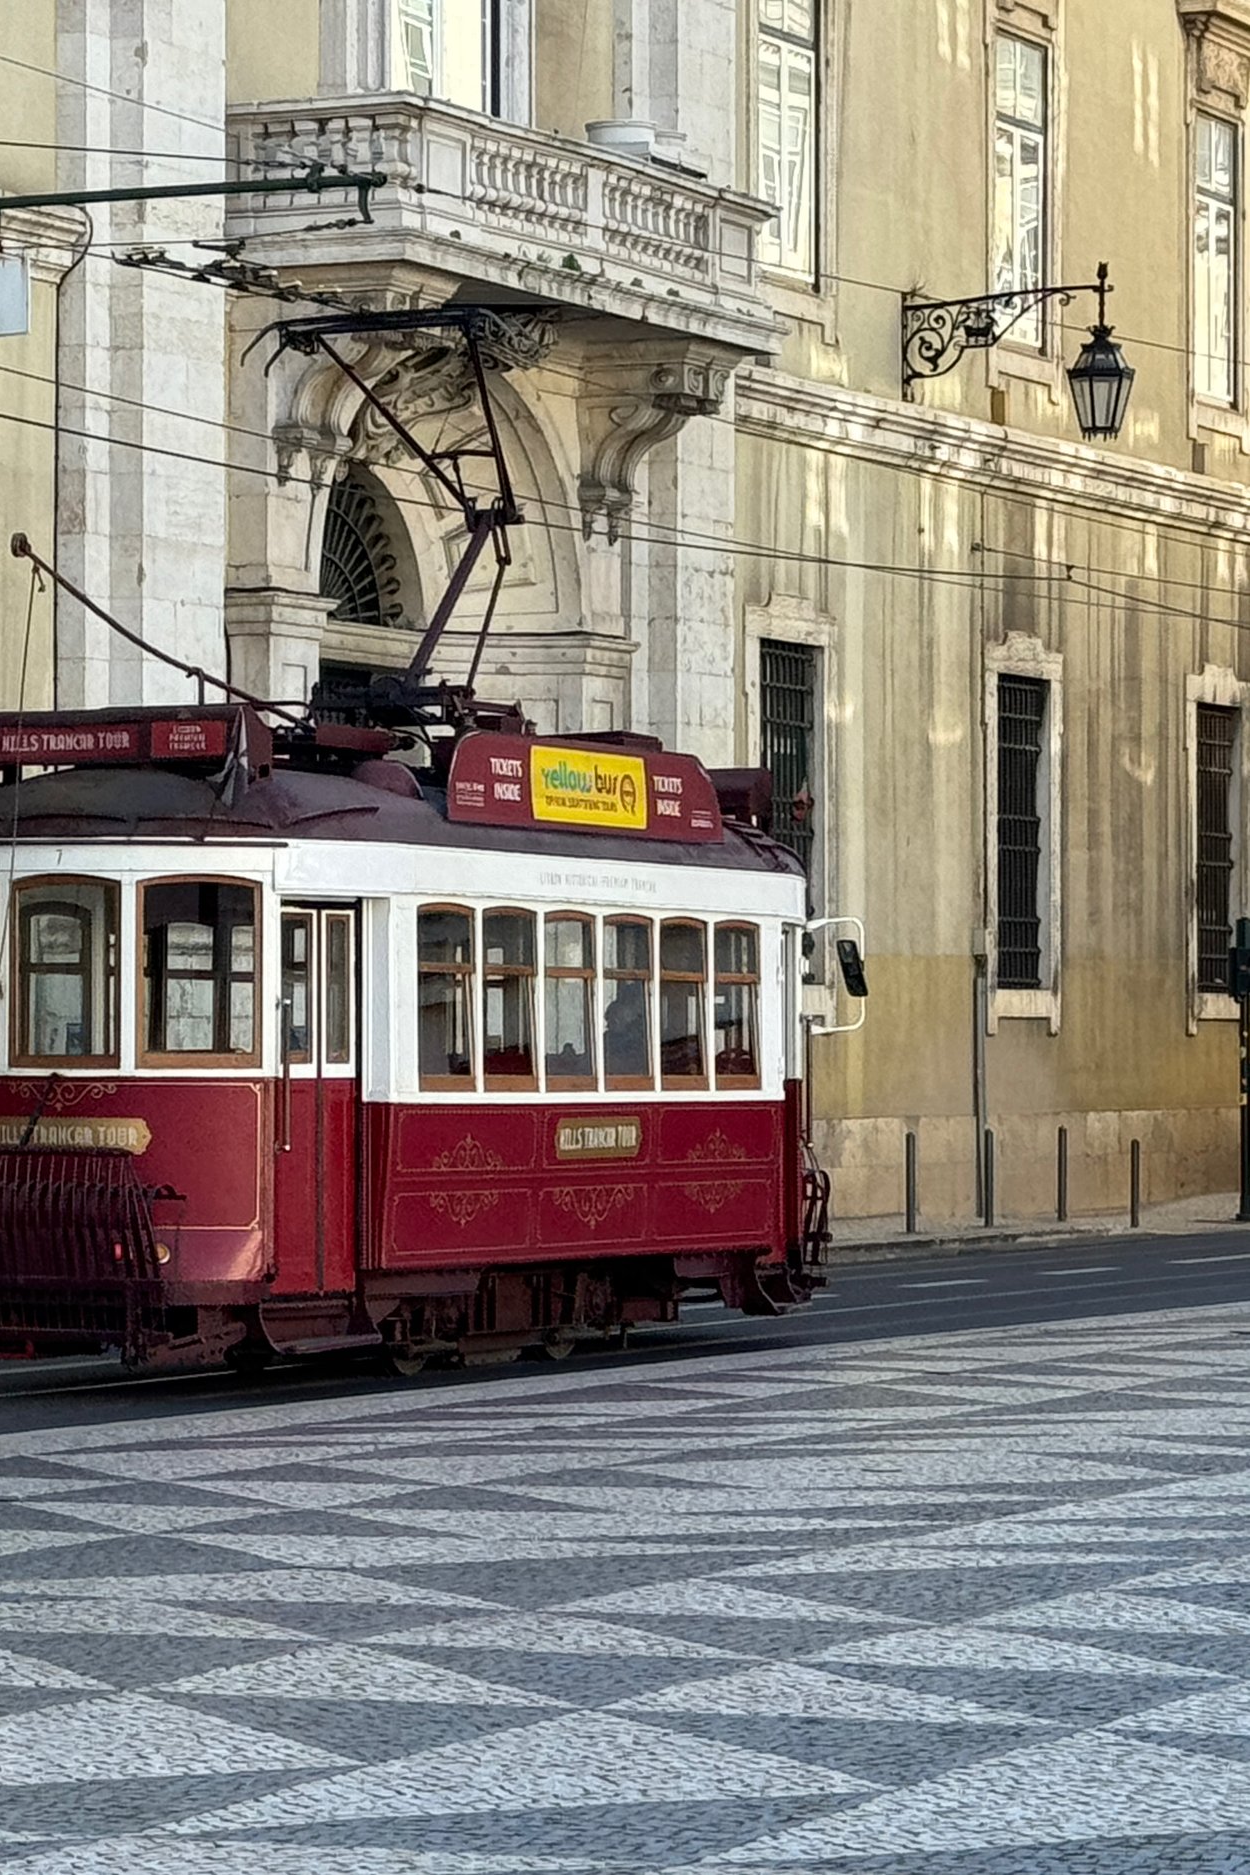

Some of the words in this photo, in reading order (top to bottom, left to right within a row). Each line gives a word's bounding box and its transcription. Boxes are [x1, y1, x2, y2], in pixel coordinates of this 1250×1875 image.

[2, 734, 38, 752] HILLS
[97, 731, 129, 749] TOUR
[489, 758, 523, 778] TICKETS
[594, 764, 618, 796] bus
[652, 776, 683, 795] TICKETS
[494, 782, 521, 801] INSIDE
[655, 799, 681, 817] INSIDE
[55, 848, 63, 865] 7
[98, 1126, 138, 1147] TOUR
[560, 1127, 582, 1150] HILLS
